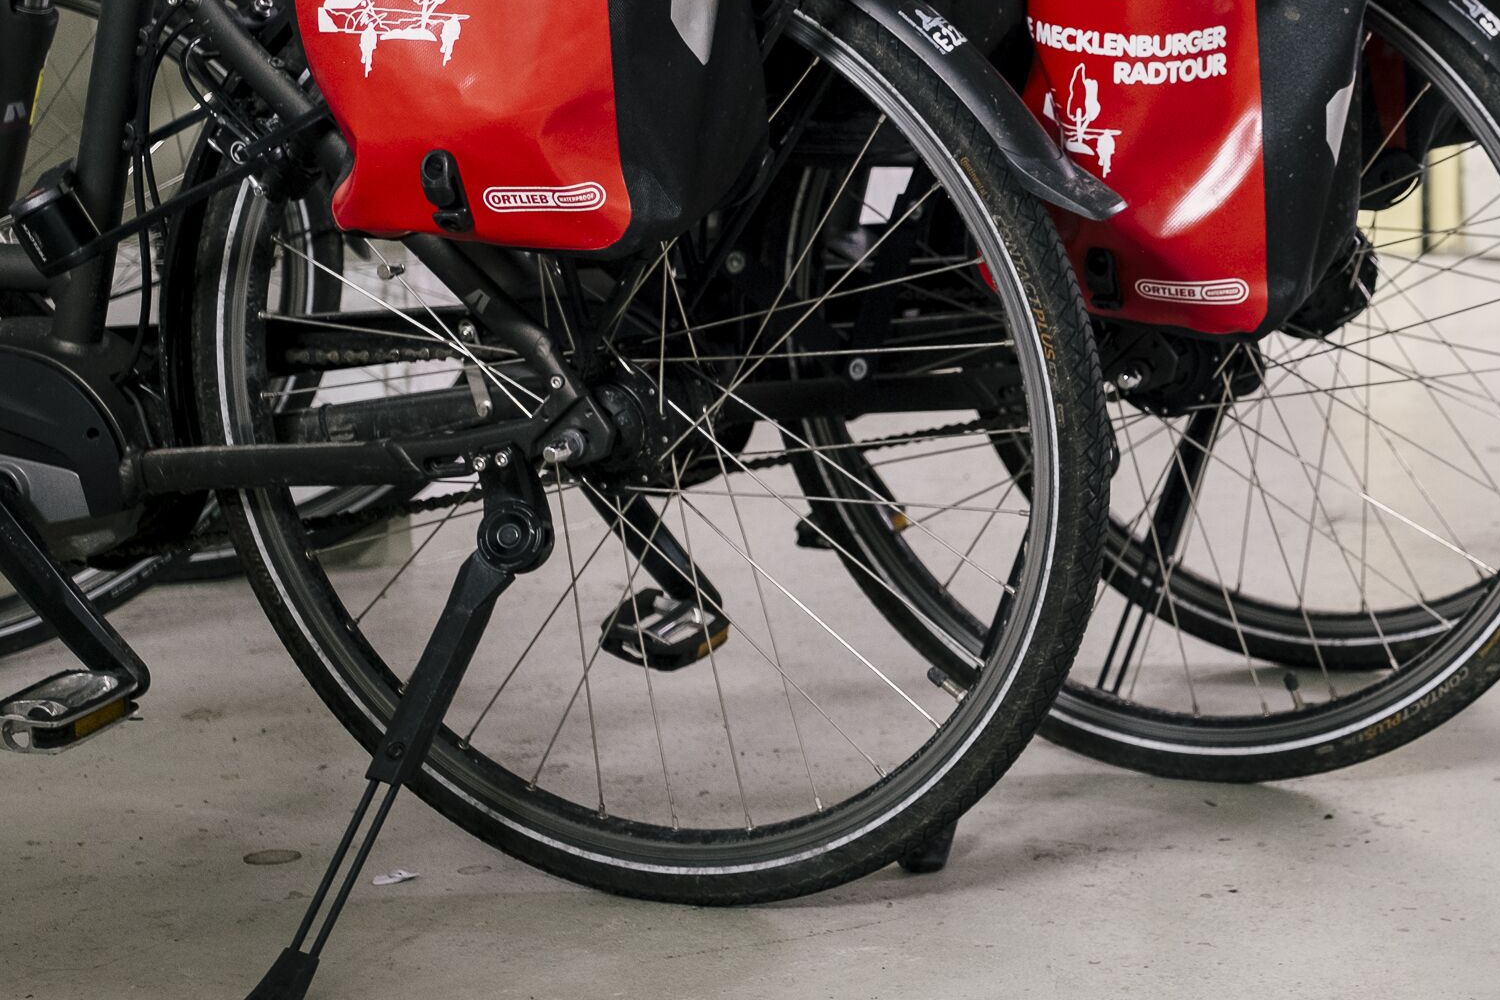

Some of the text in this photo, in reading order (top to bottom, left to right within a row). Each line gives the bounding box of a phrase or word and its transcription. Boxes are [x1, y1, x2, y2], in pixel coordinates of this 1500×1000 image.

[1036, 20, 1227, 57] MECKLENBURGER
[1113, 52, 1227, 85] RADTOUR
[491, 194, 549, 205] ORTLIEB
[1142, 284, 1196, 298] ORTLIEB
